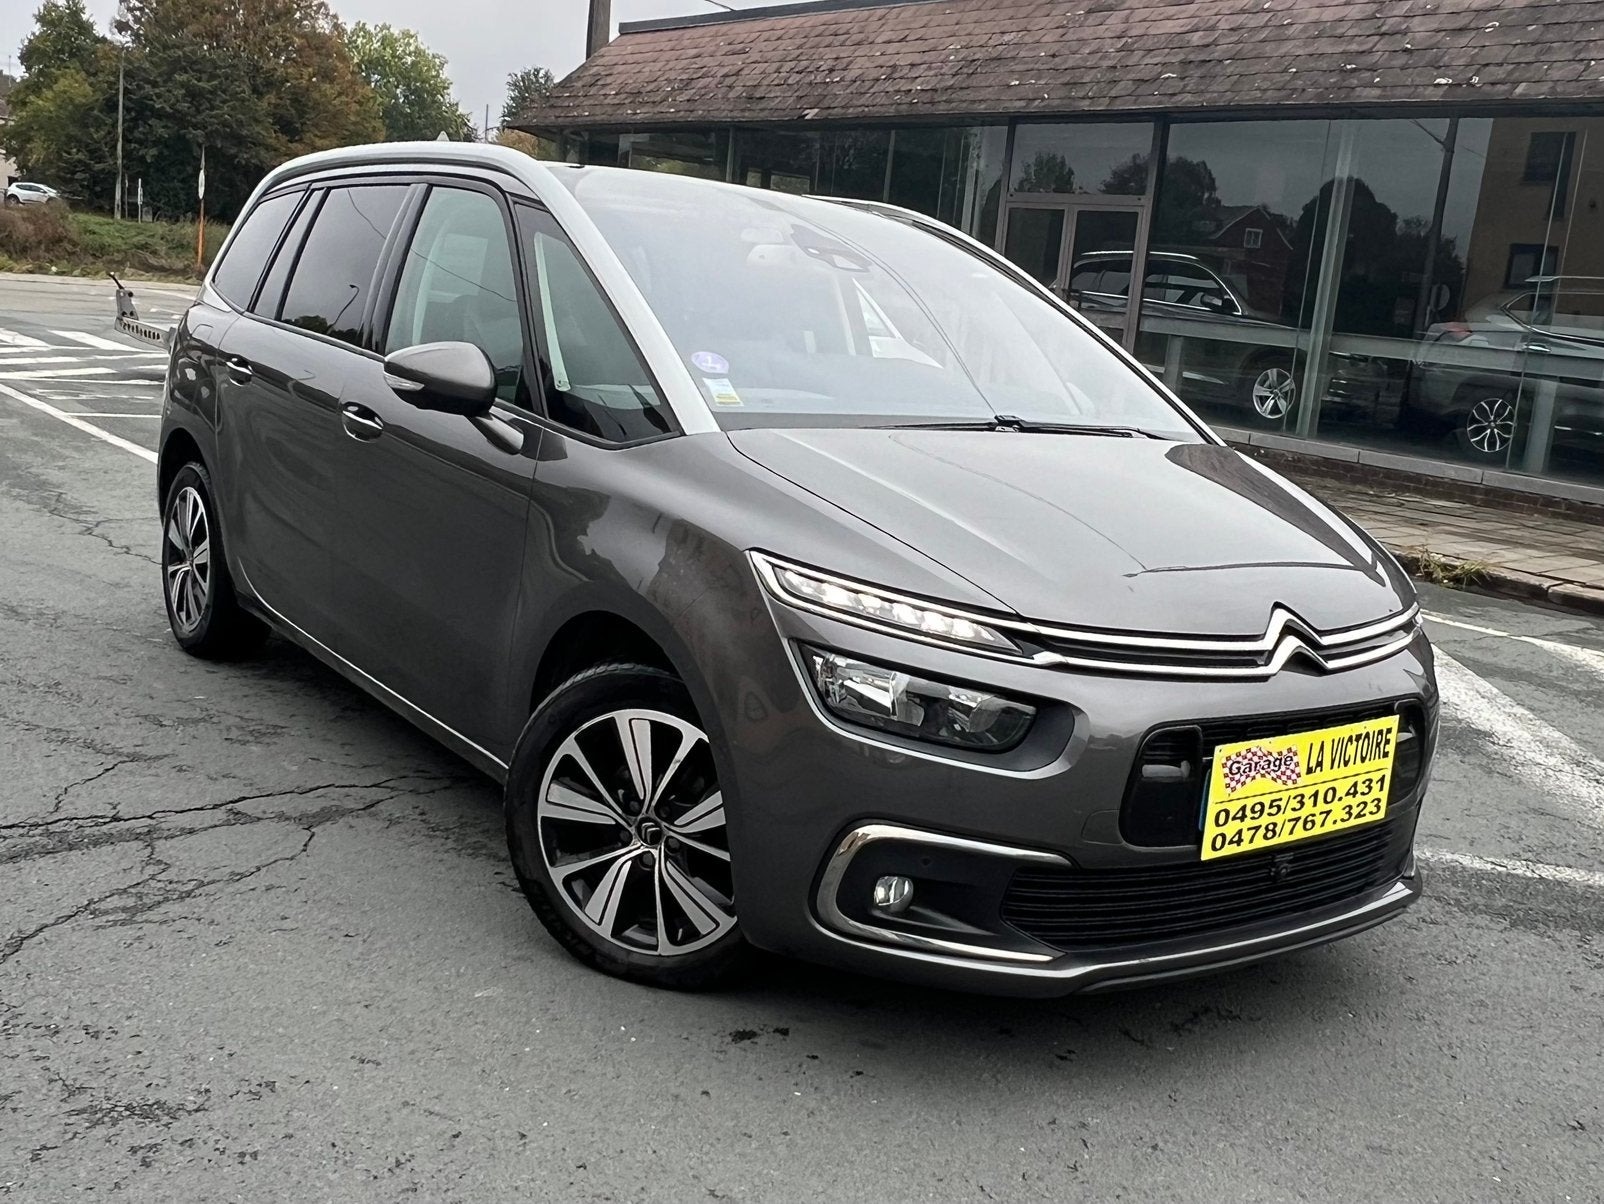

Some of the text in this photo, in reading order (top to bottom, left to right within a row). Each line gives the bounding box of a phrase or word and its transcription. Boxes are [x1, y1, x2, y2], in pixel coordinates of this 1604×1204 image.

[1228, 727, 1393, 776] Garage LA VICTOIRE
[1211, 798, 1382, 851] 0478/767.323
[1214, 774, 1386, 828] 0495/310.431
